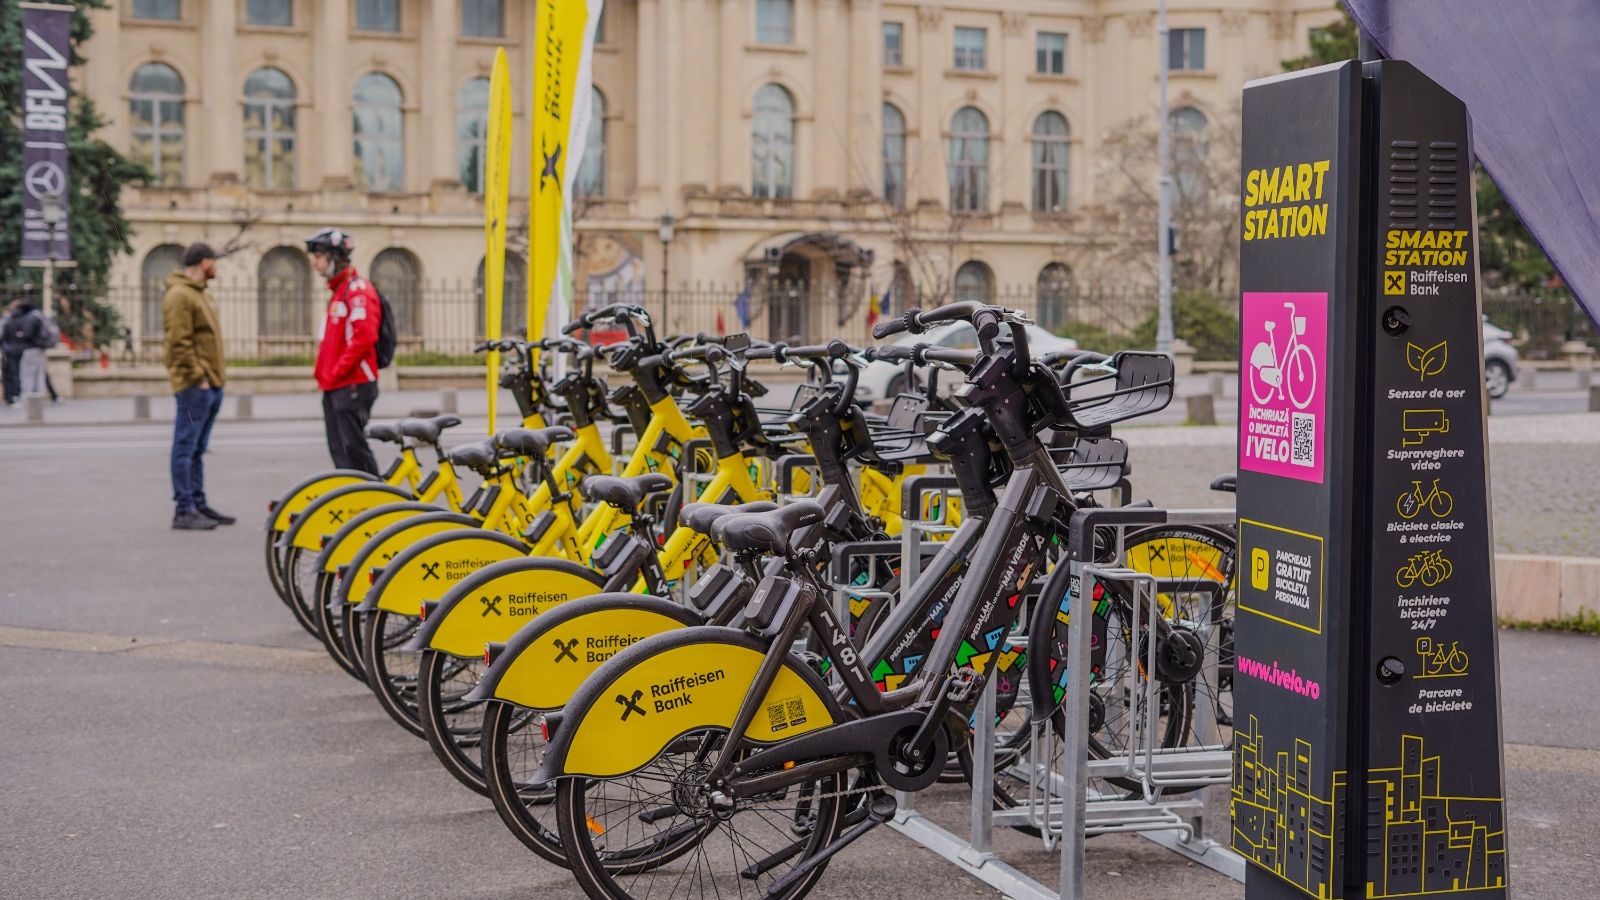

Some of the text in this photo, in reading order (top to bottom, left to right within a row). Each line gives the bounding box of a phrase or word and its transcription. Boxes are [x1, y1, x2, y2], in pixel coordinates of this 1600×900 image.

[1244, 160, 1330, 207] SMART
[1243, 203, 1328, 240] STATION
[1385, 230, 1468, 249] SMART
[1385, 250, 1468, 266] STATION
[1410, 270, 1468, 283] Raiffeisen
[1410, 284, 1440, 295] Bank
[1388, 388, 1466, 399] Senzor de aer
[1248, 421, 1255, 433] O
[1387, 448, 1465, 461] Supraveghere
[1411, 460, 1442, 470] video
[1386, 520, 1464, 532] Biciclete clasice
[1400, 533, 1451, 543] & electrice
[1010, 533, 1030, 565] VERDE
[1275, 549, 1312, 569] PARCHEAZĂ
[1275, 562, 1312, 583] GRATUIT
[509, 592, 568, 604] Raiffeisen
[1274, 590, 1310, 610] PERSONALĂ
[1398, 595, 1451, 607] Închiriere
[509, 606, 539, 616] Bank
[1400, 607, 1447, 619] biciclete
[1411, 618, 1437, 630] 24/7
[820, 610, 865, 683] 1481
[650, 669, 725, 698] Raiffeisen
[1238, 655, 1320, 700] www.ivelo.ro
[1418, 688, 1463, 700] Parcare
[654, 692, 692, 713] Bank
[1408, 701, 1473, 714] de biciclete
